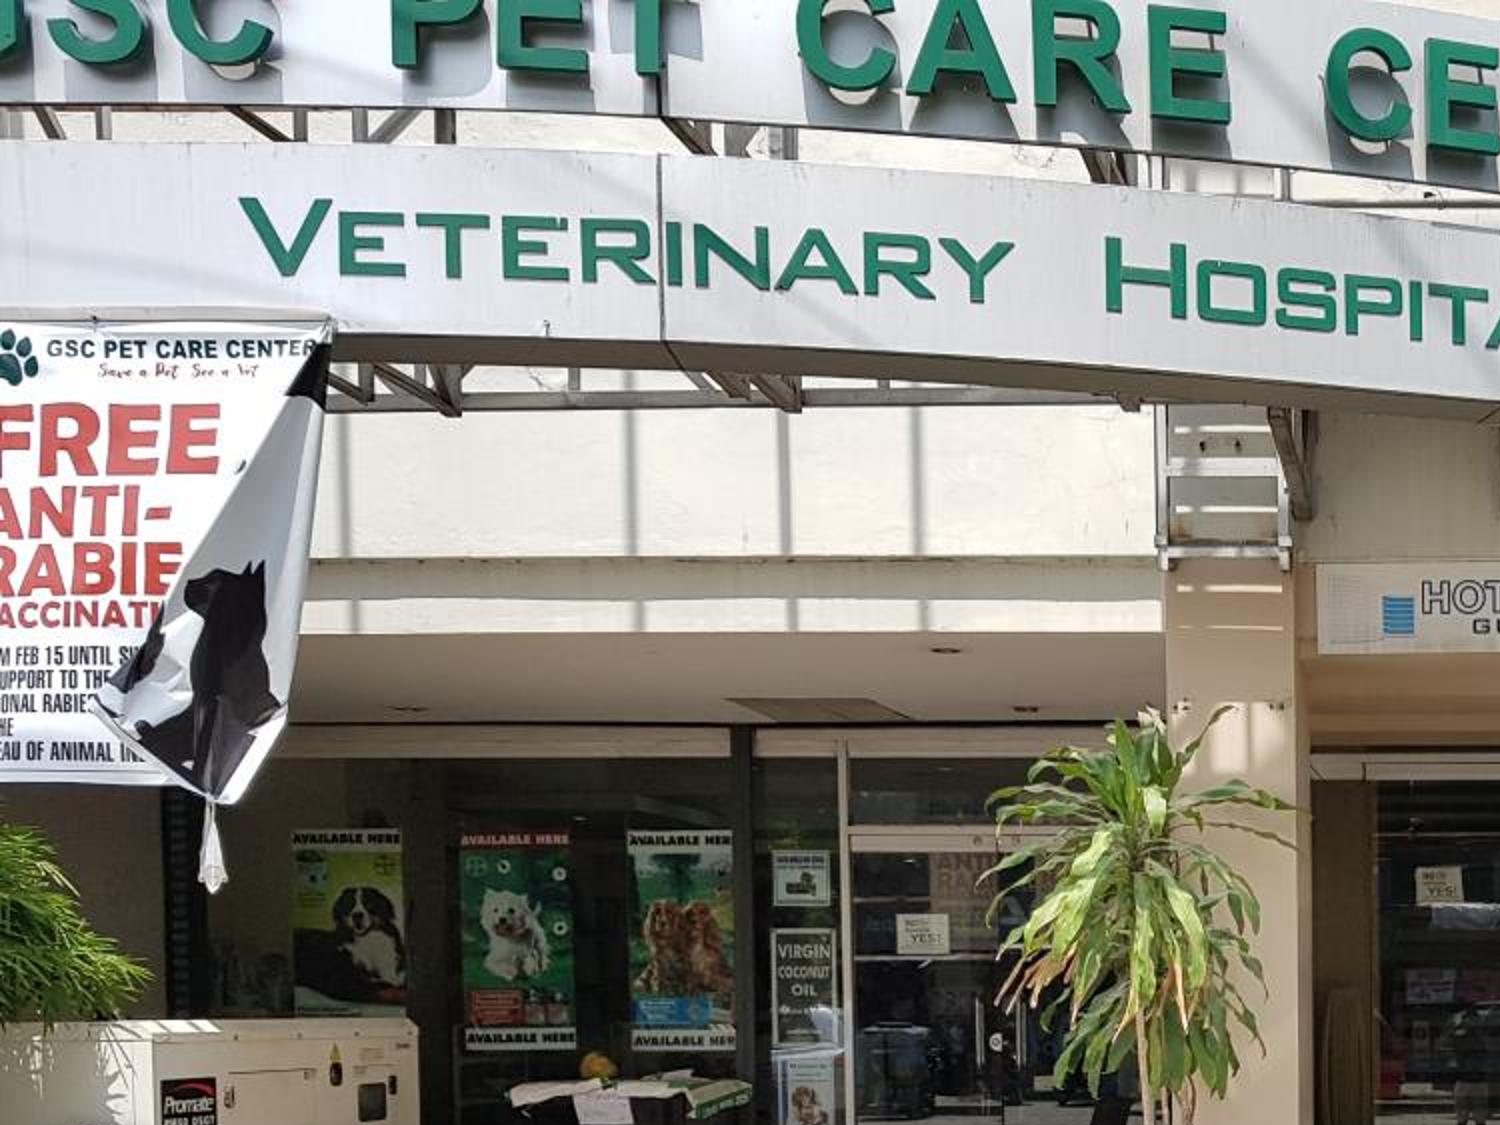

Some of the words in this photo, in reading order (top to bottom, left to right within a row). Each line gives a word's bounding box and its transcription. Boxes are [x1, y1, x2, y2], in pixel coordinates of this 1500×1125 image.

[0, 0, 275, 67] SC
[797, 0, 1232, 125] CARE
[238, 197, 1016, 304] VETERINARY
[47, 339, 96, 358] GSC
[103, 339, 147, 358] PET
[155, 339, 218, 359] CARE
[226, 338, 317, 358] CENTER
[0, 401, 221, 478] FREE
[15, 646, 39, 666] FEB
[45, 645, 64, 665] 15
[69, 646, 114, 666] UNTIL
[60, 670, 78, 689] TO
[26, 741, 45, 761] OF
[50, 741, 115, 763] ANIMAL
[291, 833, 363, 846] AVAILABLE
[367, 833, 401, 845] HERE
[461, 834, 531, 846] AVAILABLE
[535, 834, 571, 846] HERE
[629, 834, 700, 846] AVAILABLE
[777, 943, 831, 959] VIRGIN
[777, 965, 831, 979] COCONUT
[791, 984, 818, 997] OIL
[466, 1031, 538, 1045] AVAILABLE
[542, 1031, 576, 1044] HERE
[634, 1034, 705, 1047] AVAILABLE
